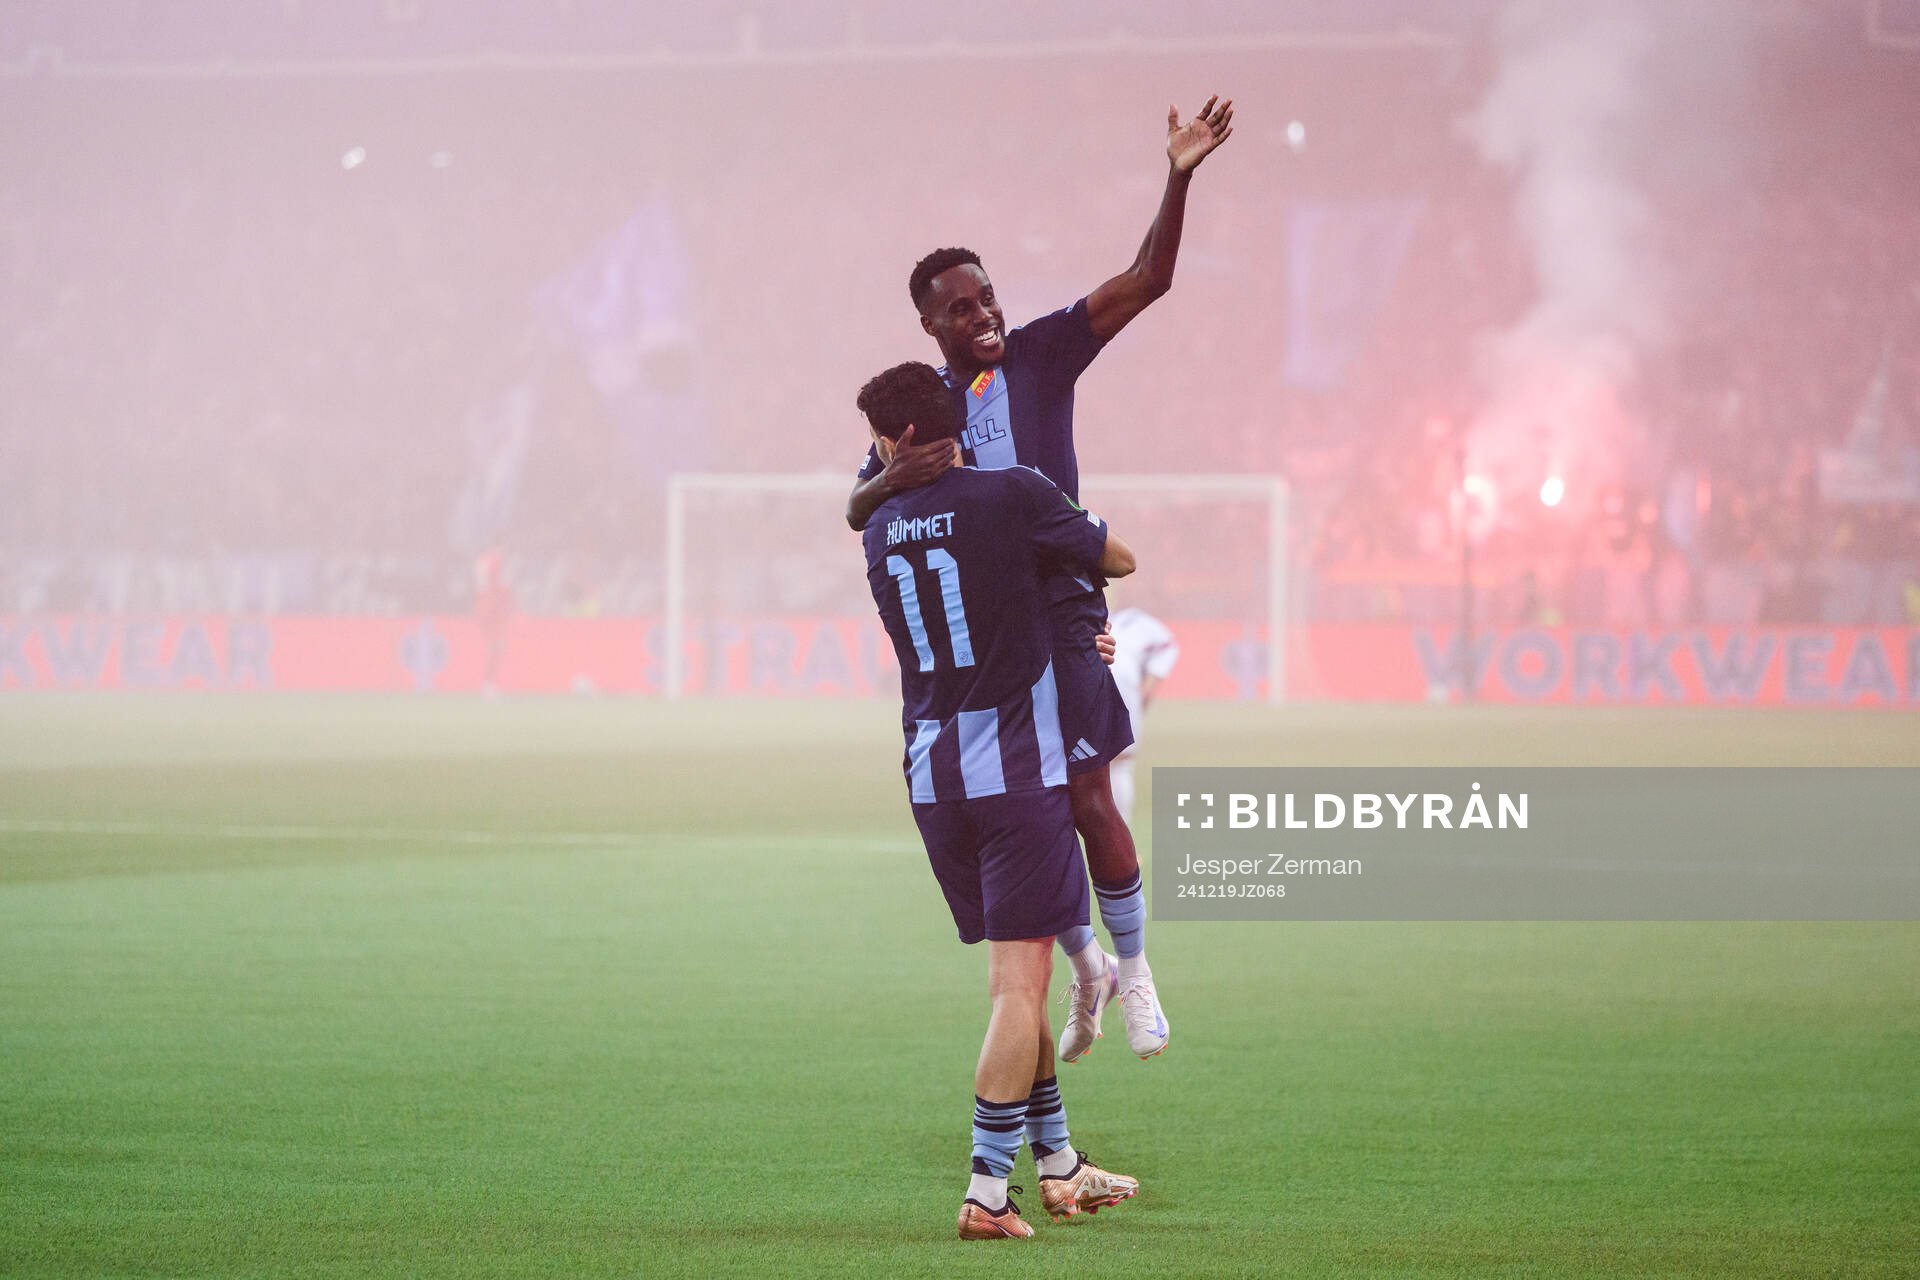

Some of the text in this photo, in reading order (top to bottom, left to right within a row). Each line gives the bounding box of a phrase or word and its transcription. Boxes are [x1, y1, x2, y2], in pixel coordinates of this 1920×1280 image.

[958, 418, 1006, 450] ILL
[886, 512, 955, 546] HÜMMET
[886, 548, 976, 672] 11
